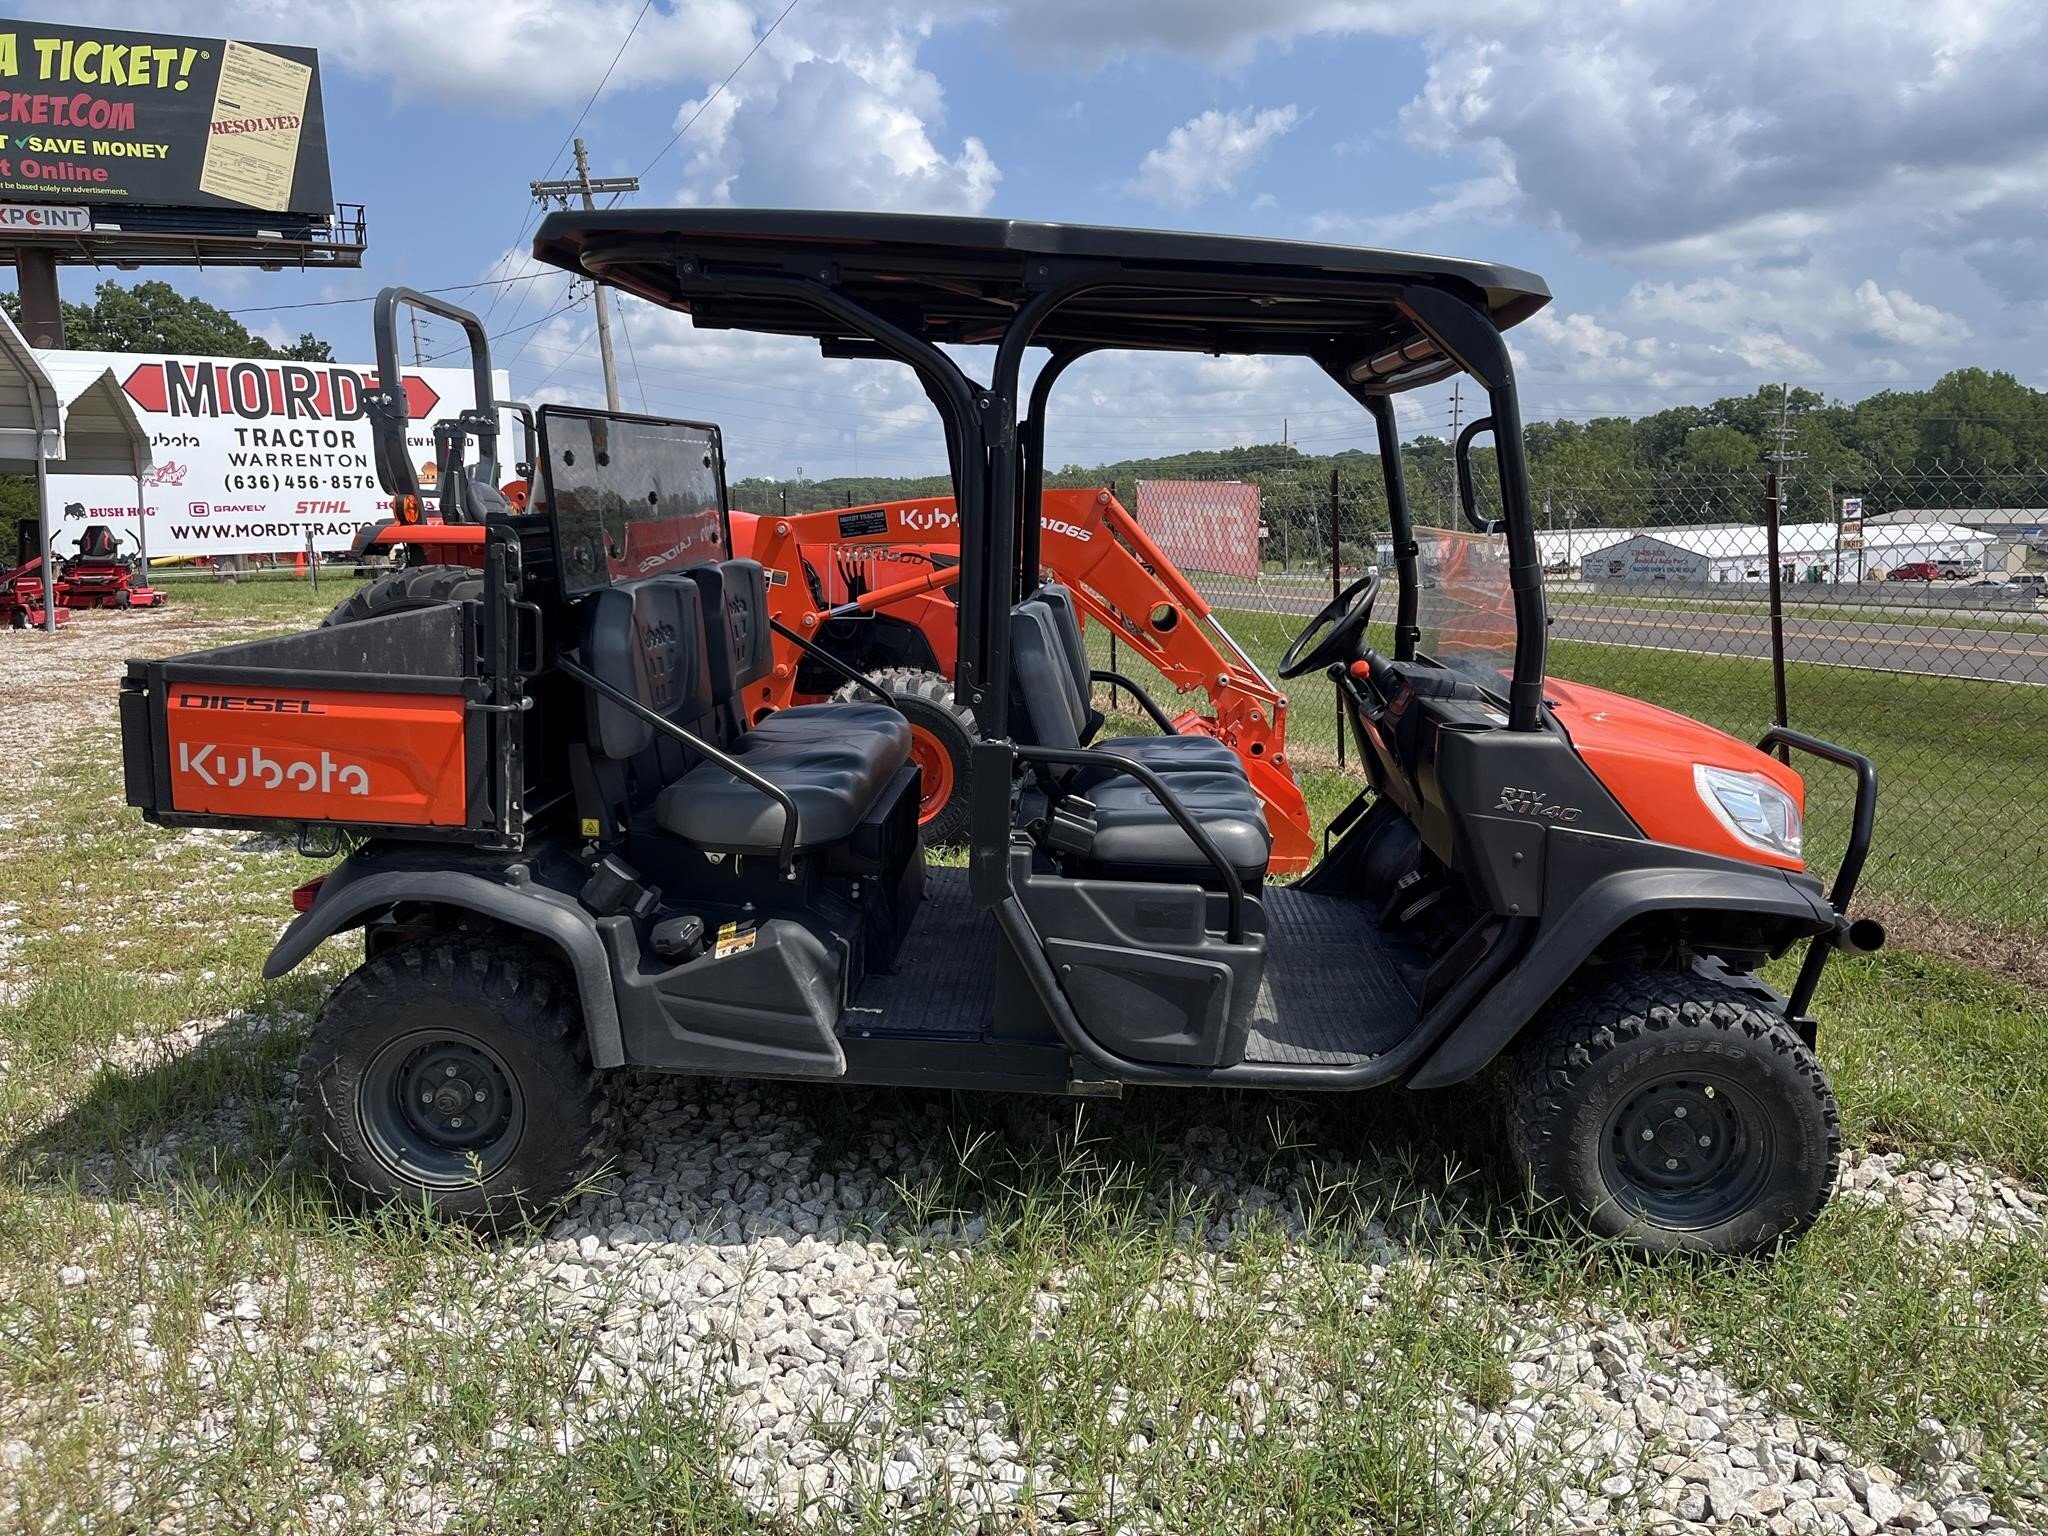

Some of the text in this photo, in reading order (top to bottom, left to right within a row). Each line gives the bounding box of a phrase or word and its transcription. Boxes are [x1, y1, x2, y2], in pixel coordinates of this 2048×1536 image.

[33, 38, 198, 91] TICKET!
[211, 115, 300, 135] RESOLVED
[29, 137, 87, 155] SAVE
[93, 139, 170, 159] MONEY
[20, 159, 109, 182] Online
[16, 182, 39, 191] based
[39, 184, 61, 194] solely
[72, 186, 129, 195] advertisements.
[165, 360, 381, 421] MORD
[151, 432, 200, 447] ubota
[234, 427, 356, 449] TRACTOR
[407, 437, 424, 447] EW
[228, 452, 368, 469] WARRENTON
[90, 508, 124, 517] BUSH
[213, 504, 266, 513] GRAVELY
[295, 500, 351, 514] STIHL
[1041, 516, 1093, 542] A1065
[1844, 523, 1861, 532] AUTO
[1844, 540, 1862, 548] PARTS
[179, 693, 326, 715] DIESEL
[179, 742, 369, 796] Kubota
[1500, 786, 1547, 802] RTV
[1493, 796, 1583, 823] X1140
